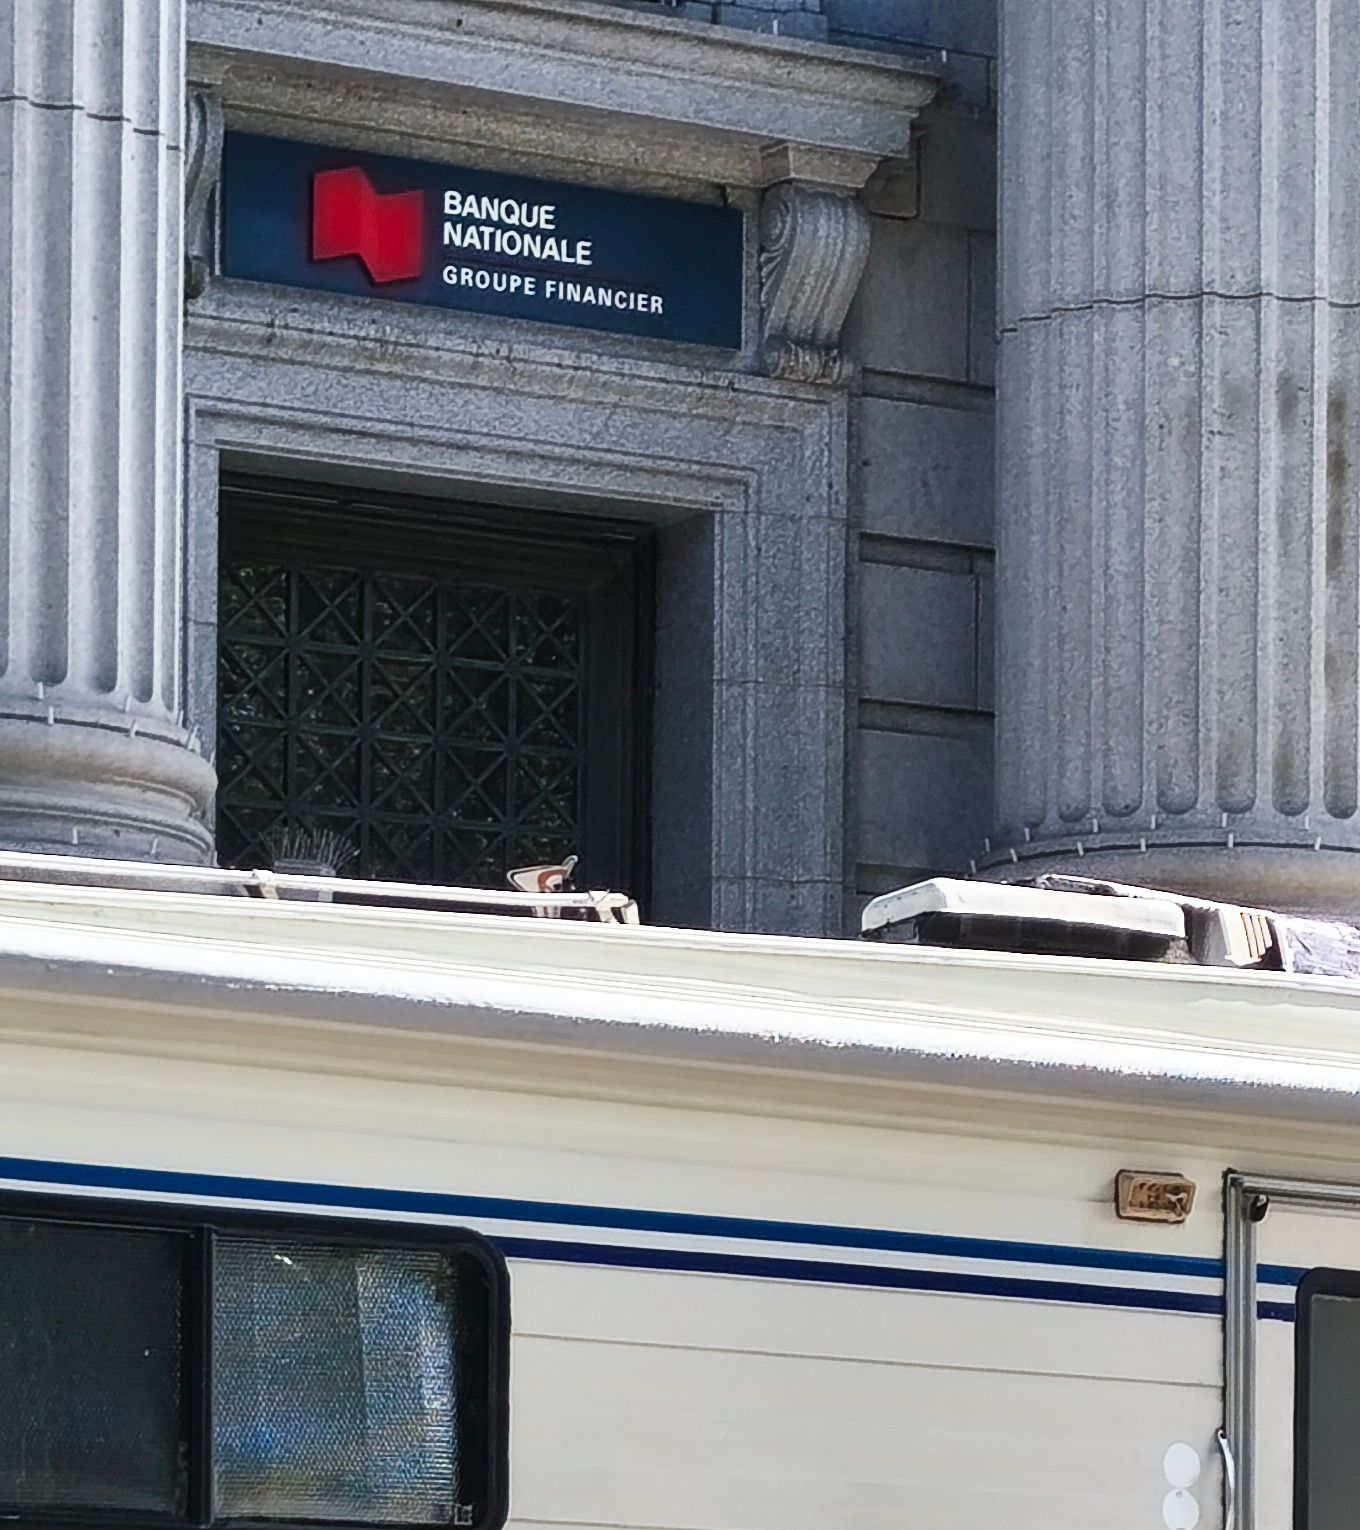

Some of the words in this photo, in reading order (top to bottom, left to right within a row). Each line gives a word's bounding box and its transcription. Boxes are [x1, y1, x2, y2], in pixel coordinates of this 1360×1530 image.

[443, 190, 556, 231] BANQUE
[443, 221, 593, 266] NATIONALE
[443, 265, 537, 296] GROUPE
[545, 279, 665, 315] FINANCIER
